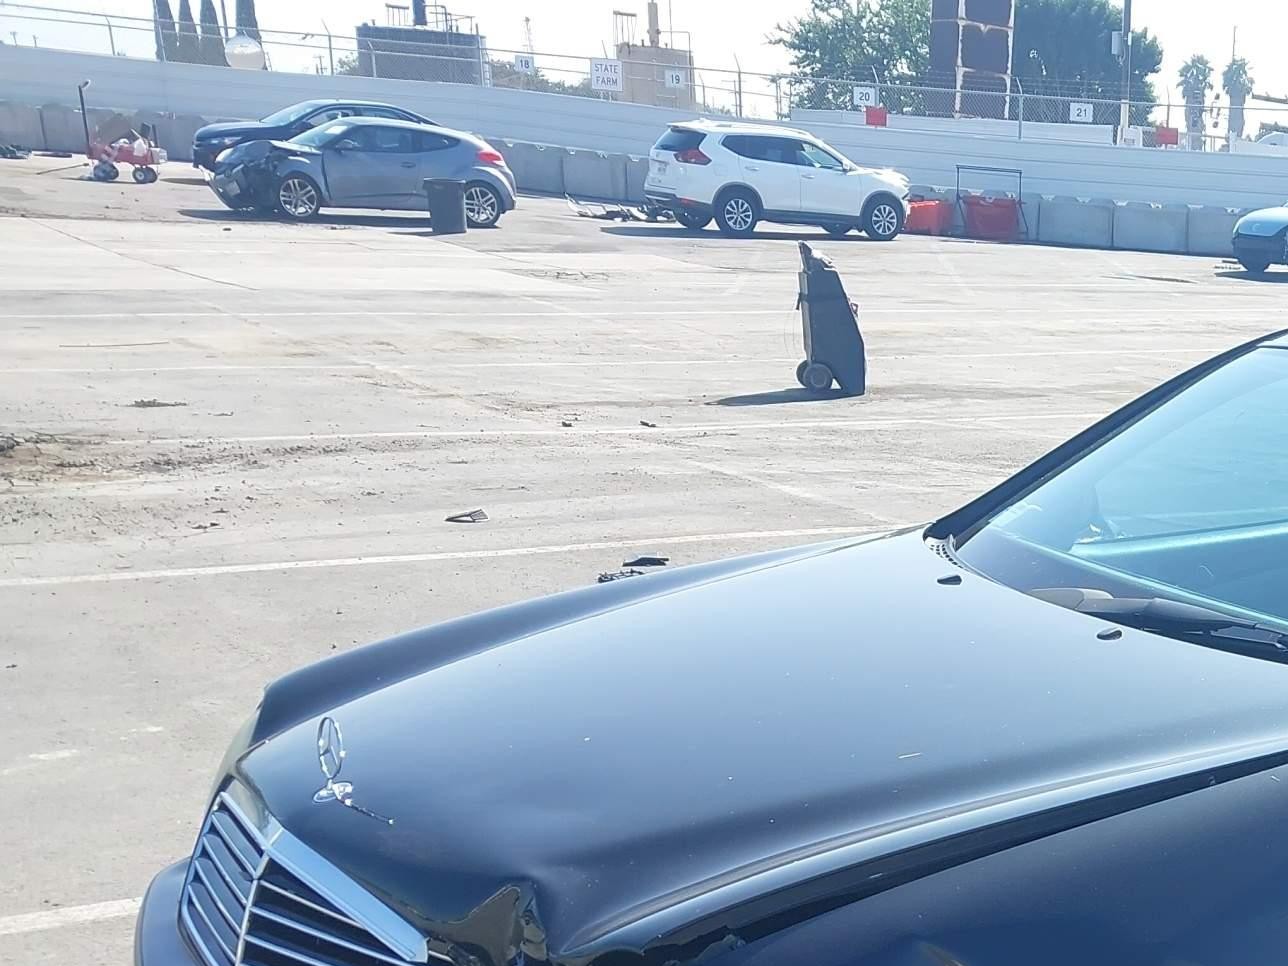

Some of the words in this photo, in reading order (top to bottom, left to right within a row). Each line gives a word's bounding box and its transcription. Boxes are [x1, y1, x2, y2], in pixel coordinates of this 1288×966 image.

[519, 58, 530, 69] 18
[594, 63, 619, 74] STATE
[595, 75, 618, 86] FARM
[671, 74, 681, 84] 19
[858, 91, 870, 101] 20
[1076, 107, 1087, 117] 21
